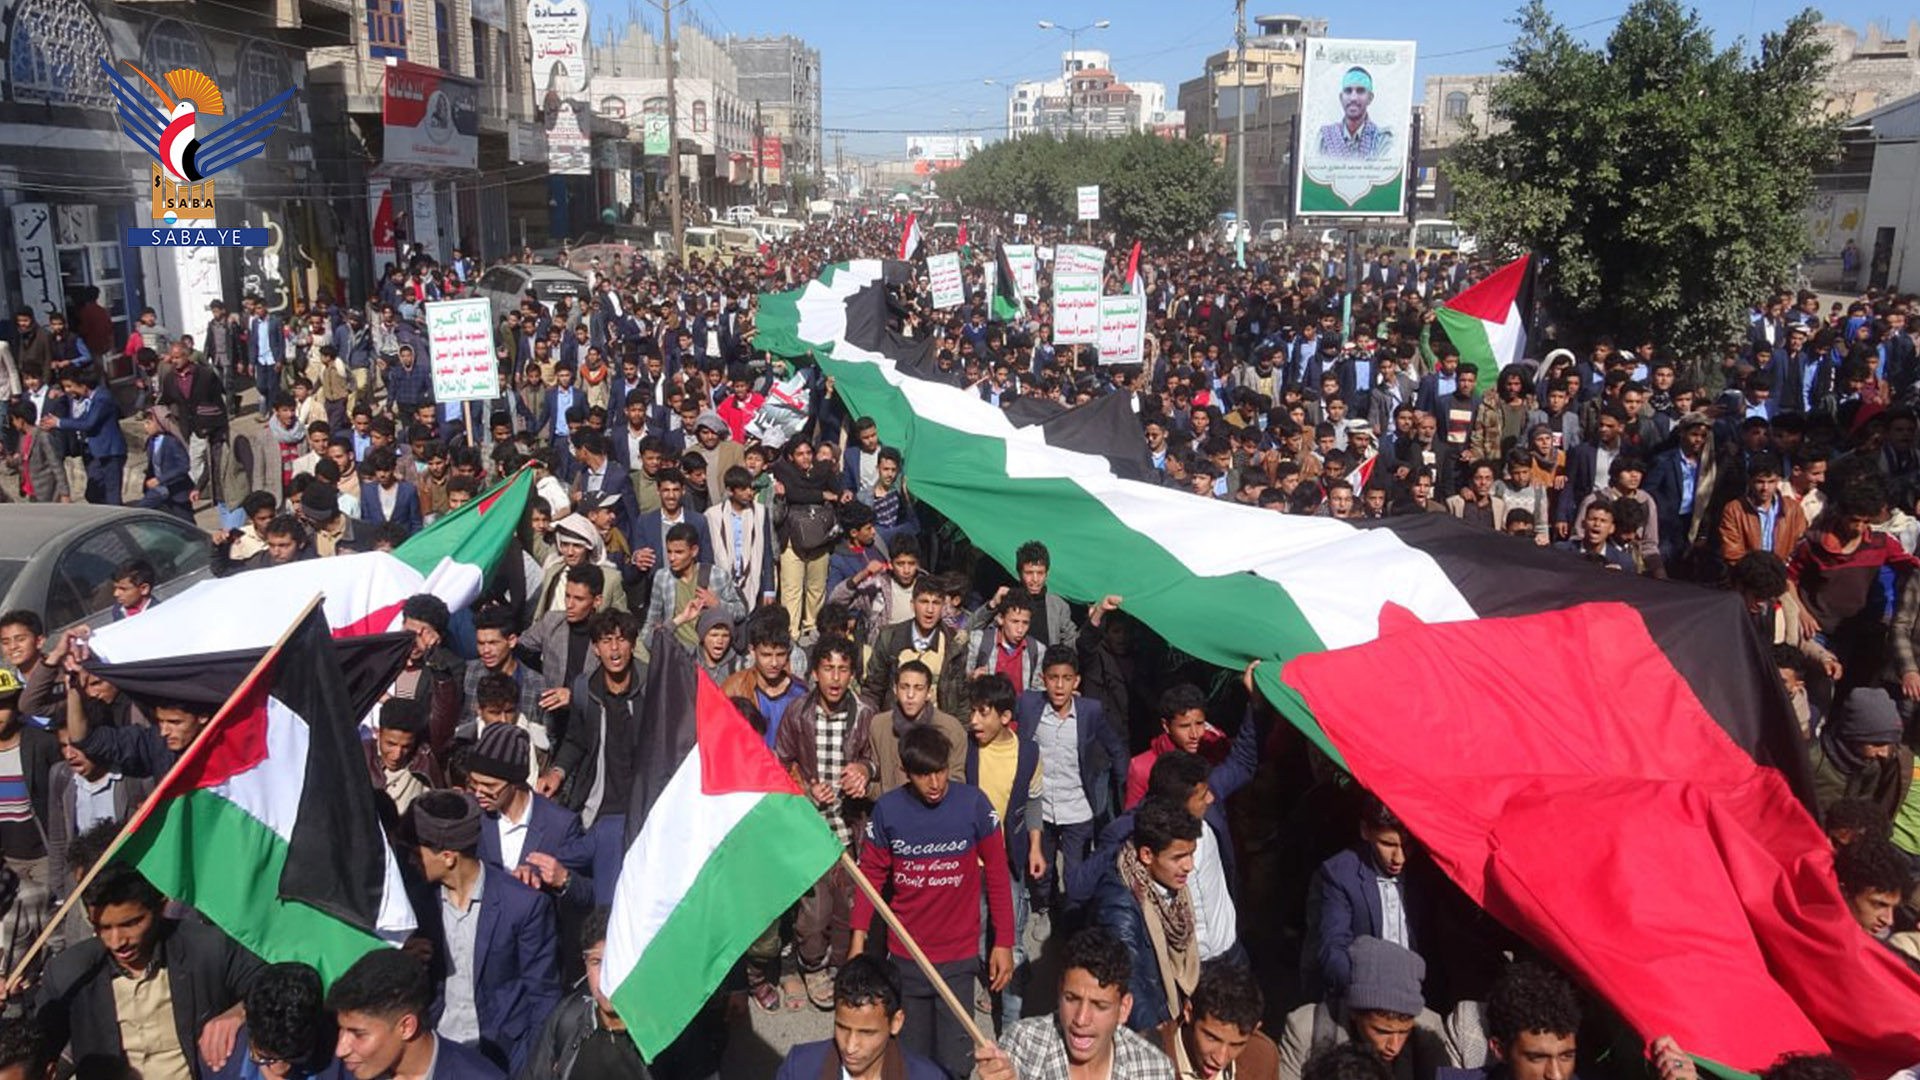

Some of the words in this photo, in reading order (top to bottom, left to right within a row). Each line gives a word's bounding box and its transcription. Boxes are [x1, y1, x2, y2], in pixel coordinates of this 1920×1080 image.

[534, 4, 577, 21] عيادة
[466, 308, 487, 322] الله
[891, 839, 967, 855] Because
[903, 860, 925, 871] I'm
[894, 872, 925, 887] Don't
